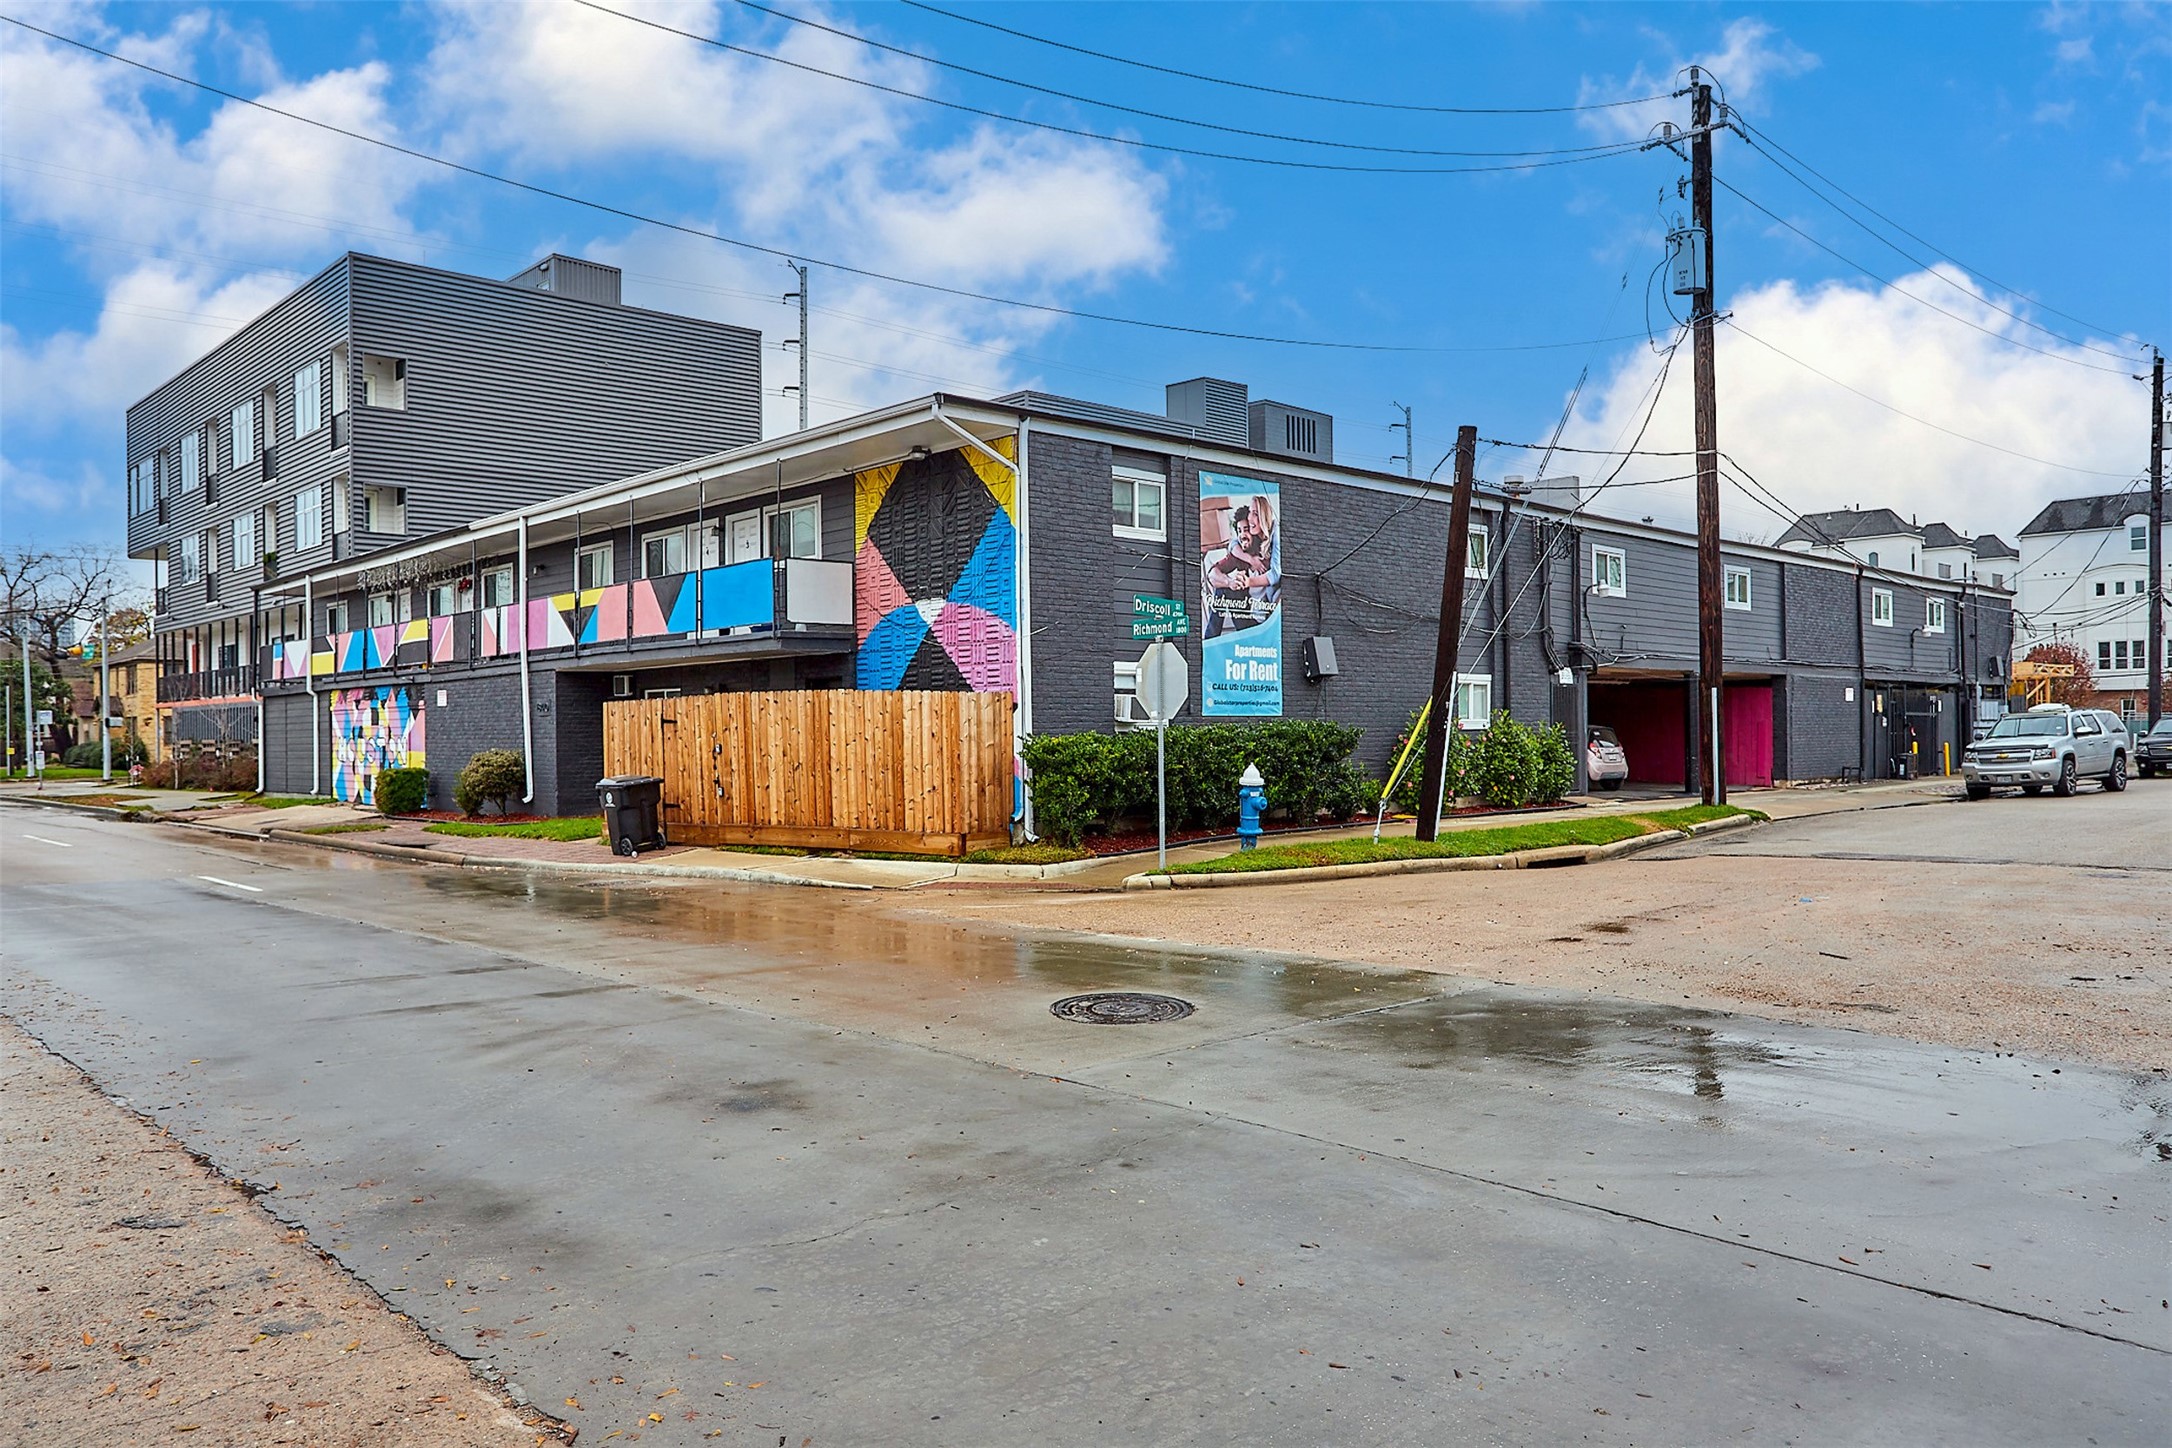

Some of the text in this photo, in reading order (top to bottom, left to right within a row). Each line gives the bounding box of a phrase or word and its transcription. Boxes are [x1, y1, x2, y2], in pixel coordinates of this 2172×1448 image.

[1135, 599, 1170, 616] Driscoll
[1205, 594, 1248, 613] Richmond
[1133, 621, 1172, 636] Richmond
[1234, 644, 1277, 658] Apartments
[1225, 659, 1278, 681] For Rent
[1229, 683, 1239, 691] US:
